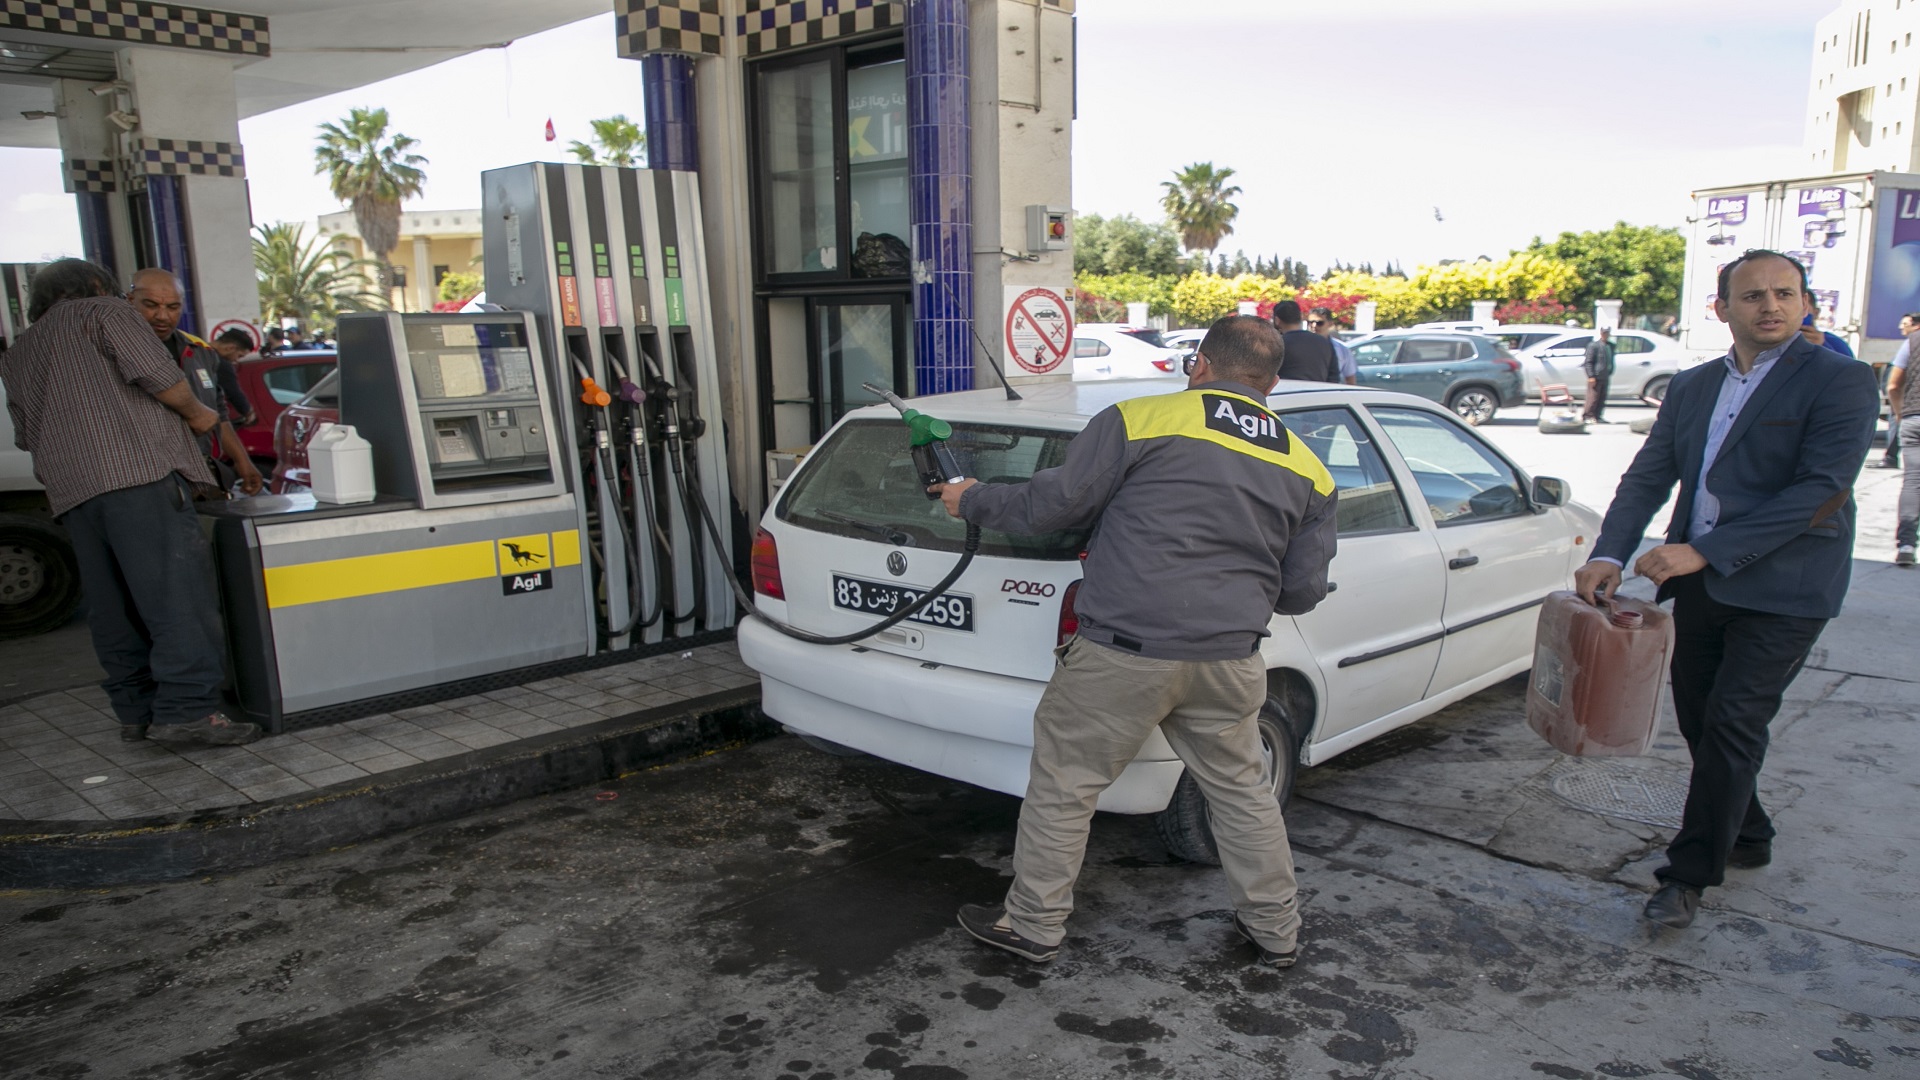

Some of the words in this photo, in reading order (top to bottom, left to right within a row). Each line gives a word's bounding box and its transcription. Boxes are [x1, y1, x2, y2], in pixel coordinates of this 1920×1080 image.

[565, 277, 573, 302] GASOIL
[1214, 399, 1279, 439] Agil
[512, 573, 542, 591] Agil
[1001, 578, 1056, 598] POLO
[837, 578, 862, 608] 83
[867, 588, 899, 613] تونس
